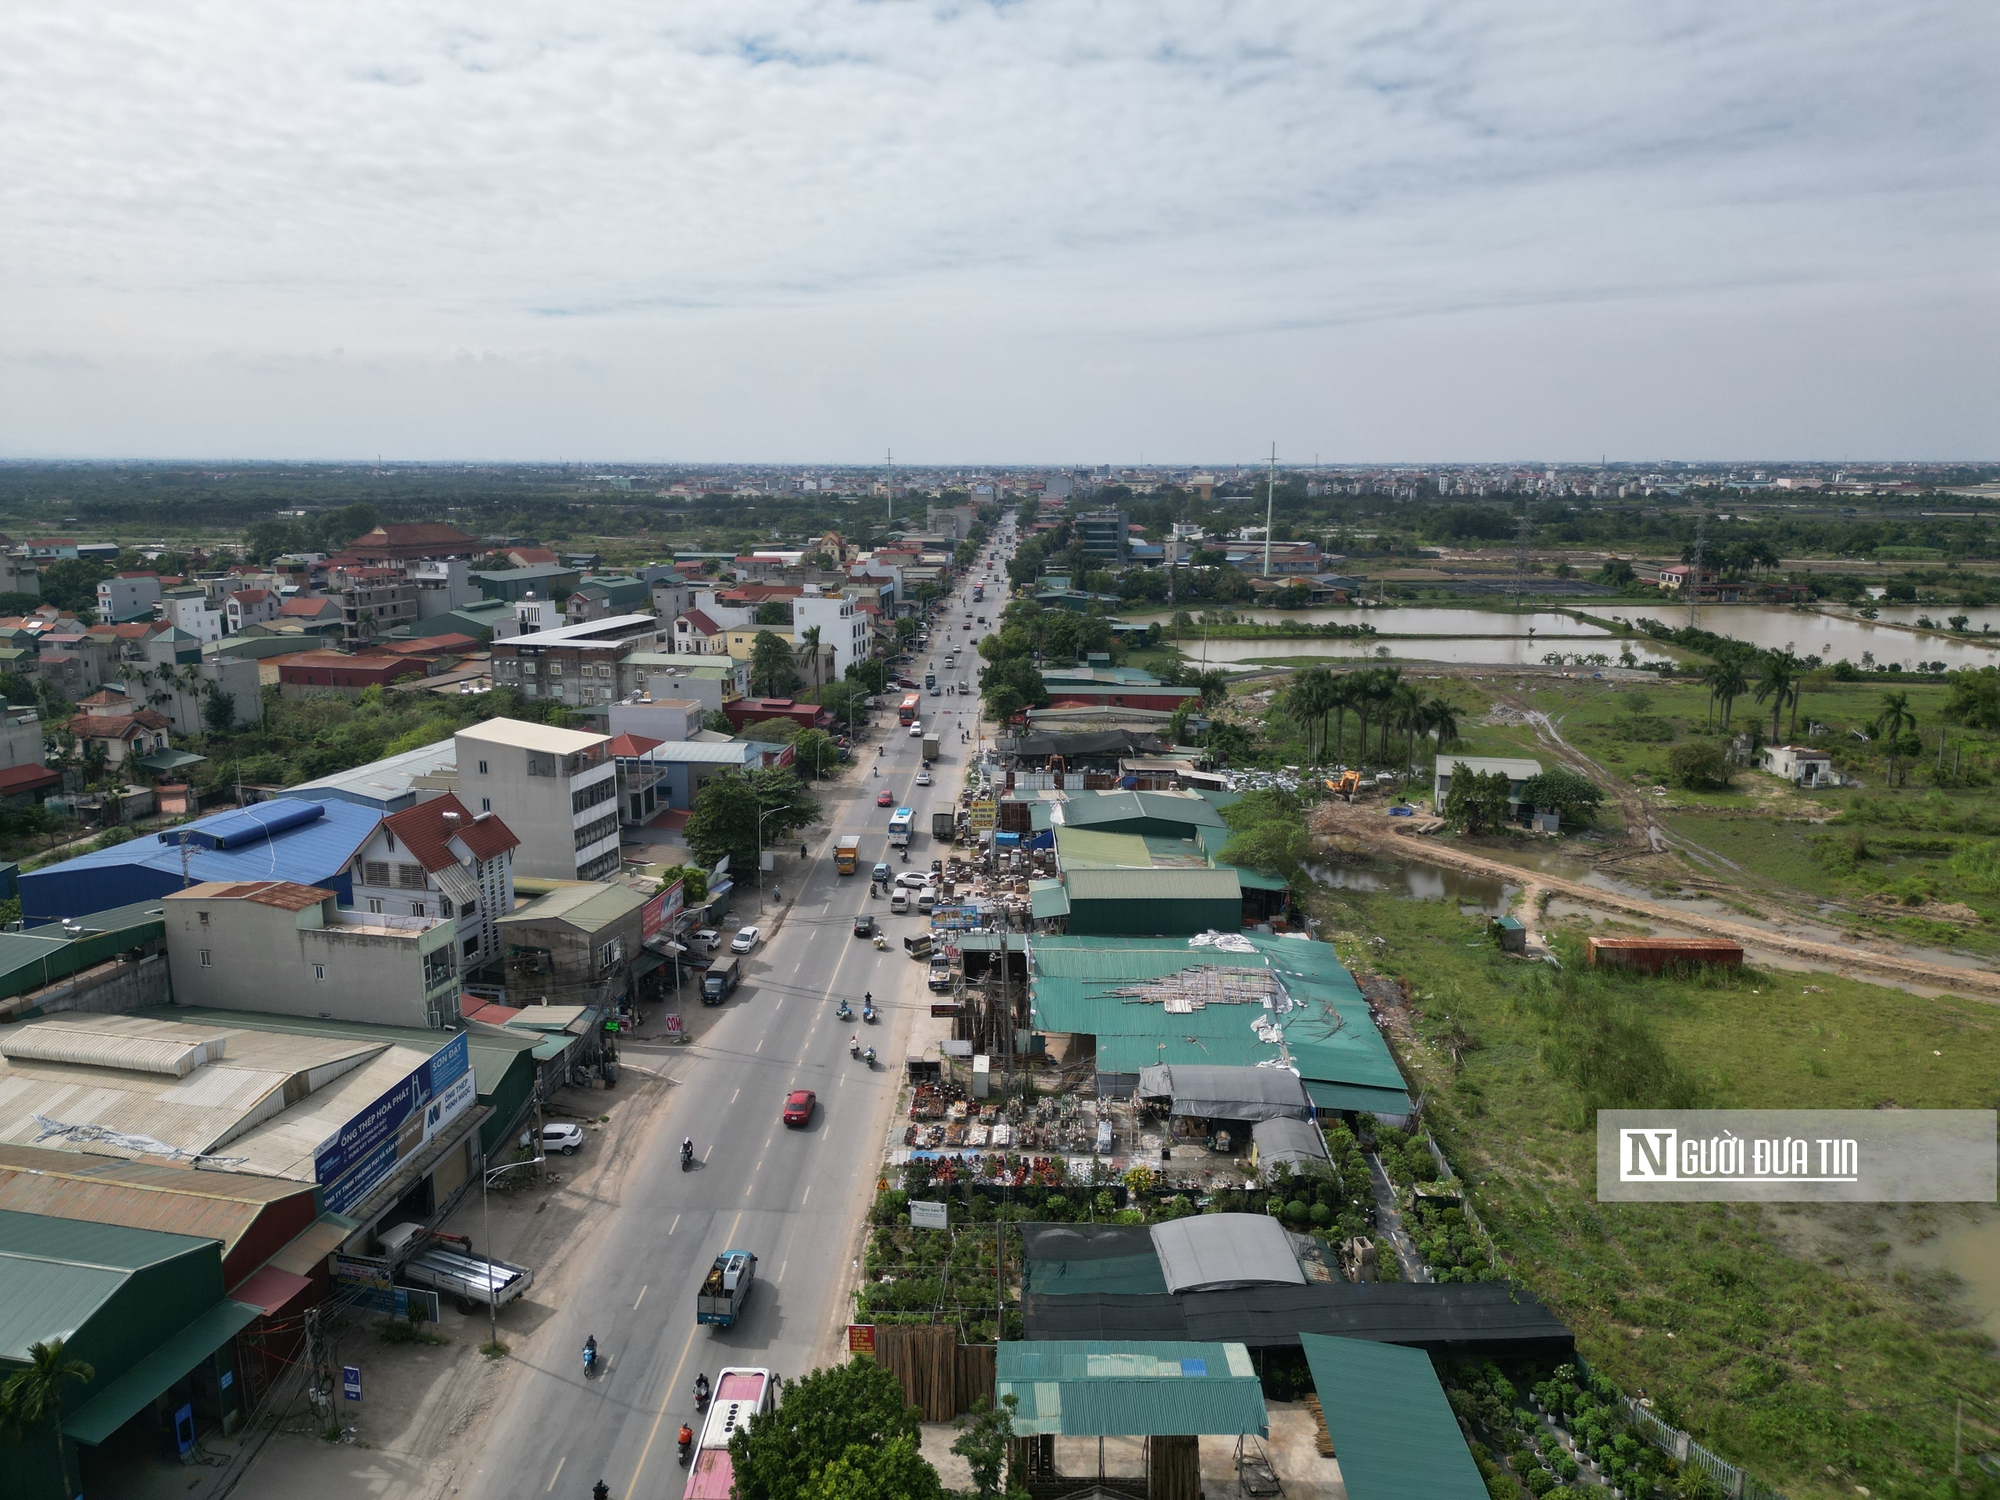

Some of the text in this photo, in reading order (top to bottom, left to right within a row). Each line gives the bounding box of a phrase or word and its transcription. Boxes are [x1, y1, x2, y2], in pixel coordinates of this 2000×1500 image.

[432, 1056, 447, 1072] SƠN
[449, 1043, 462, 1059] ĐẠT
[445, 1097, 458, 1112] MINH
[458, 1085, 472, 1104] NGỌC
[456, 1078, 469, 1093] THÉP
[341, 1087, 410, 1147] ỐNG THÉP HÒA PHÁT
[324, 1196, 336, 1207] ÔNG
